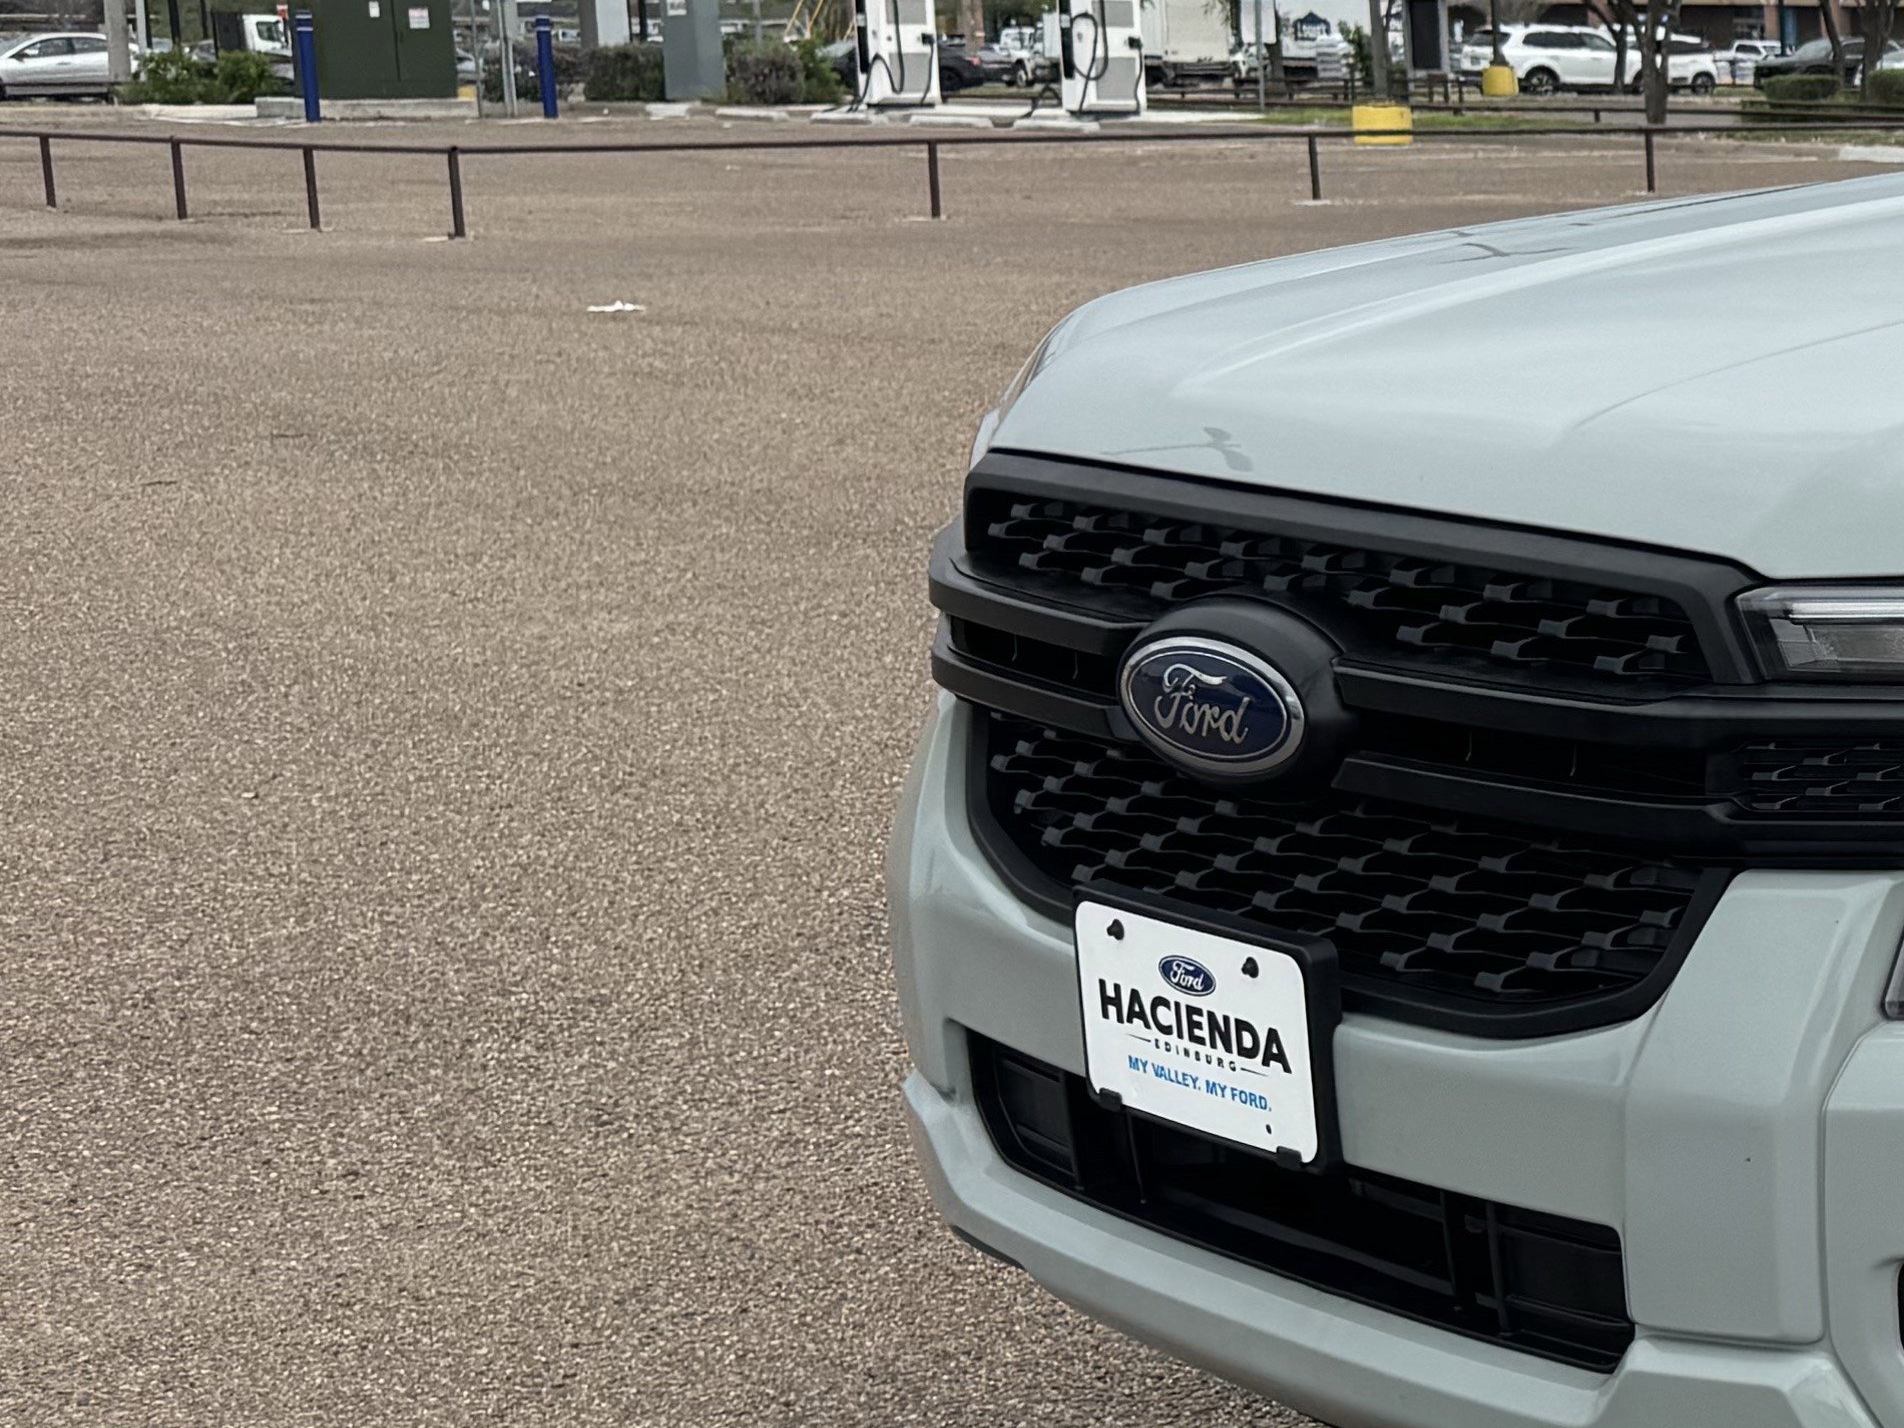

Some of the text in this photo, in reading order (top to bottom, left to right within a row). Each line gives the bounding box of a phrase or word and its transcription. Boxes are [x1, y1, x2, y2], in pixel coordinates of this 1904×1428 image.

[1154, 662, 1250, 745] Ford
[1168, 959, 1206, 992] Ford
[1098, 977, 1293, 1075] HACIENDA
[1127, 1054, 1149, 1075] MY
[1205, 1078, 1228, 1099] MY
[1153, 1037, 1237, 1073] EDINBURG
